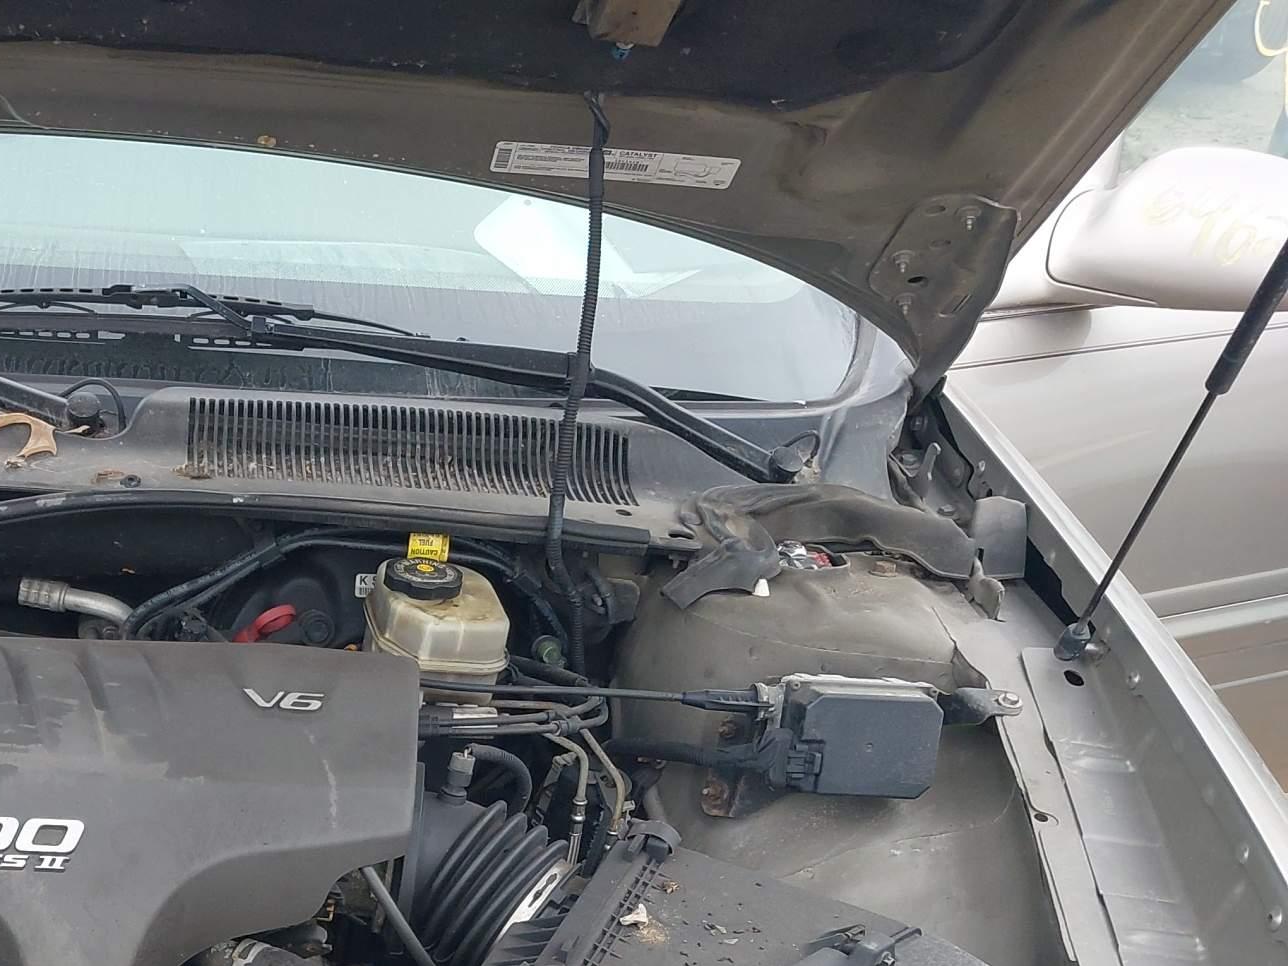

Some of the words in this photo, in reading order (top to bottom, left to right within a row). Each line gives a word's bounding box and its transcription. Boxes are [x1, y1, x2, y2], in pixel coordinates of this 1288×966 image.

[418, 538, 434, 546] FUEL
[410, 548, 438, 556] CAUTION
[243, 688, 325, 711] V6
[33, 855, 70, 871] II
